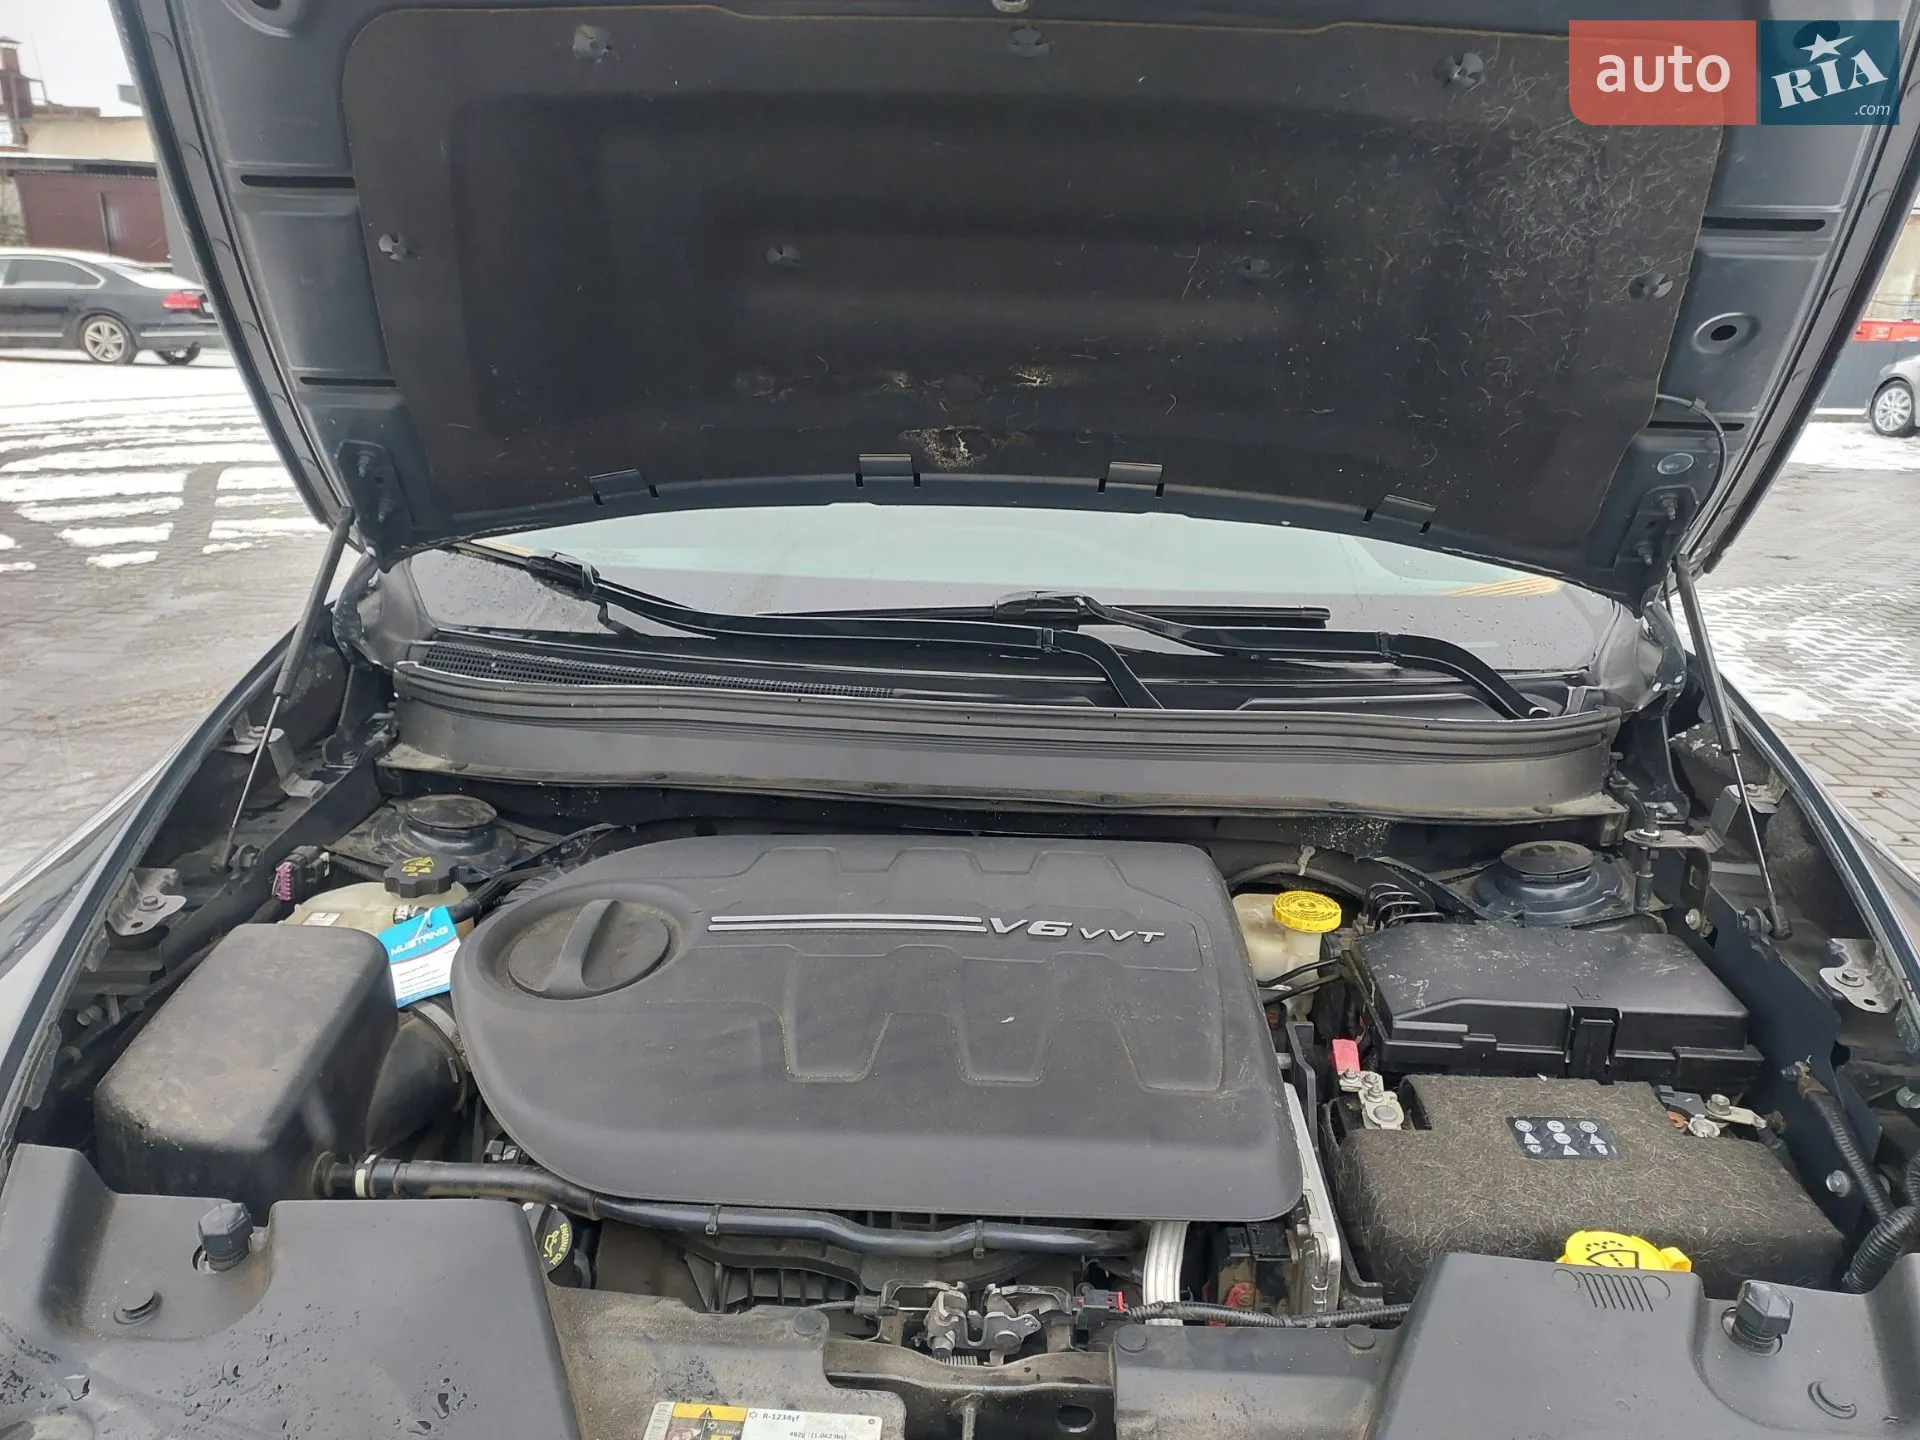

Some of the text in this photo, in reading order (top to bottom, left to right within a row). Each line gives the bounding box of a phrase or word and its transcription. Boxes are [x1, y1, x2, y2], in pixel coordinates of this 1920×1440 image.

[390, 925, 449, 956] MUSTANG
[989, 917, 1165, 943] V6 VVT
[549, 1223, 569, 1266] ENGINE OIL
[762, 1413, 800, 1423] R-1234yf
